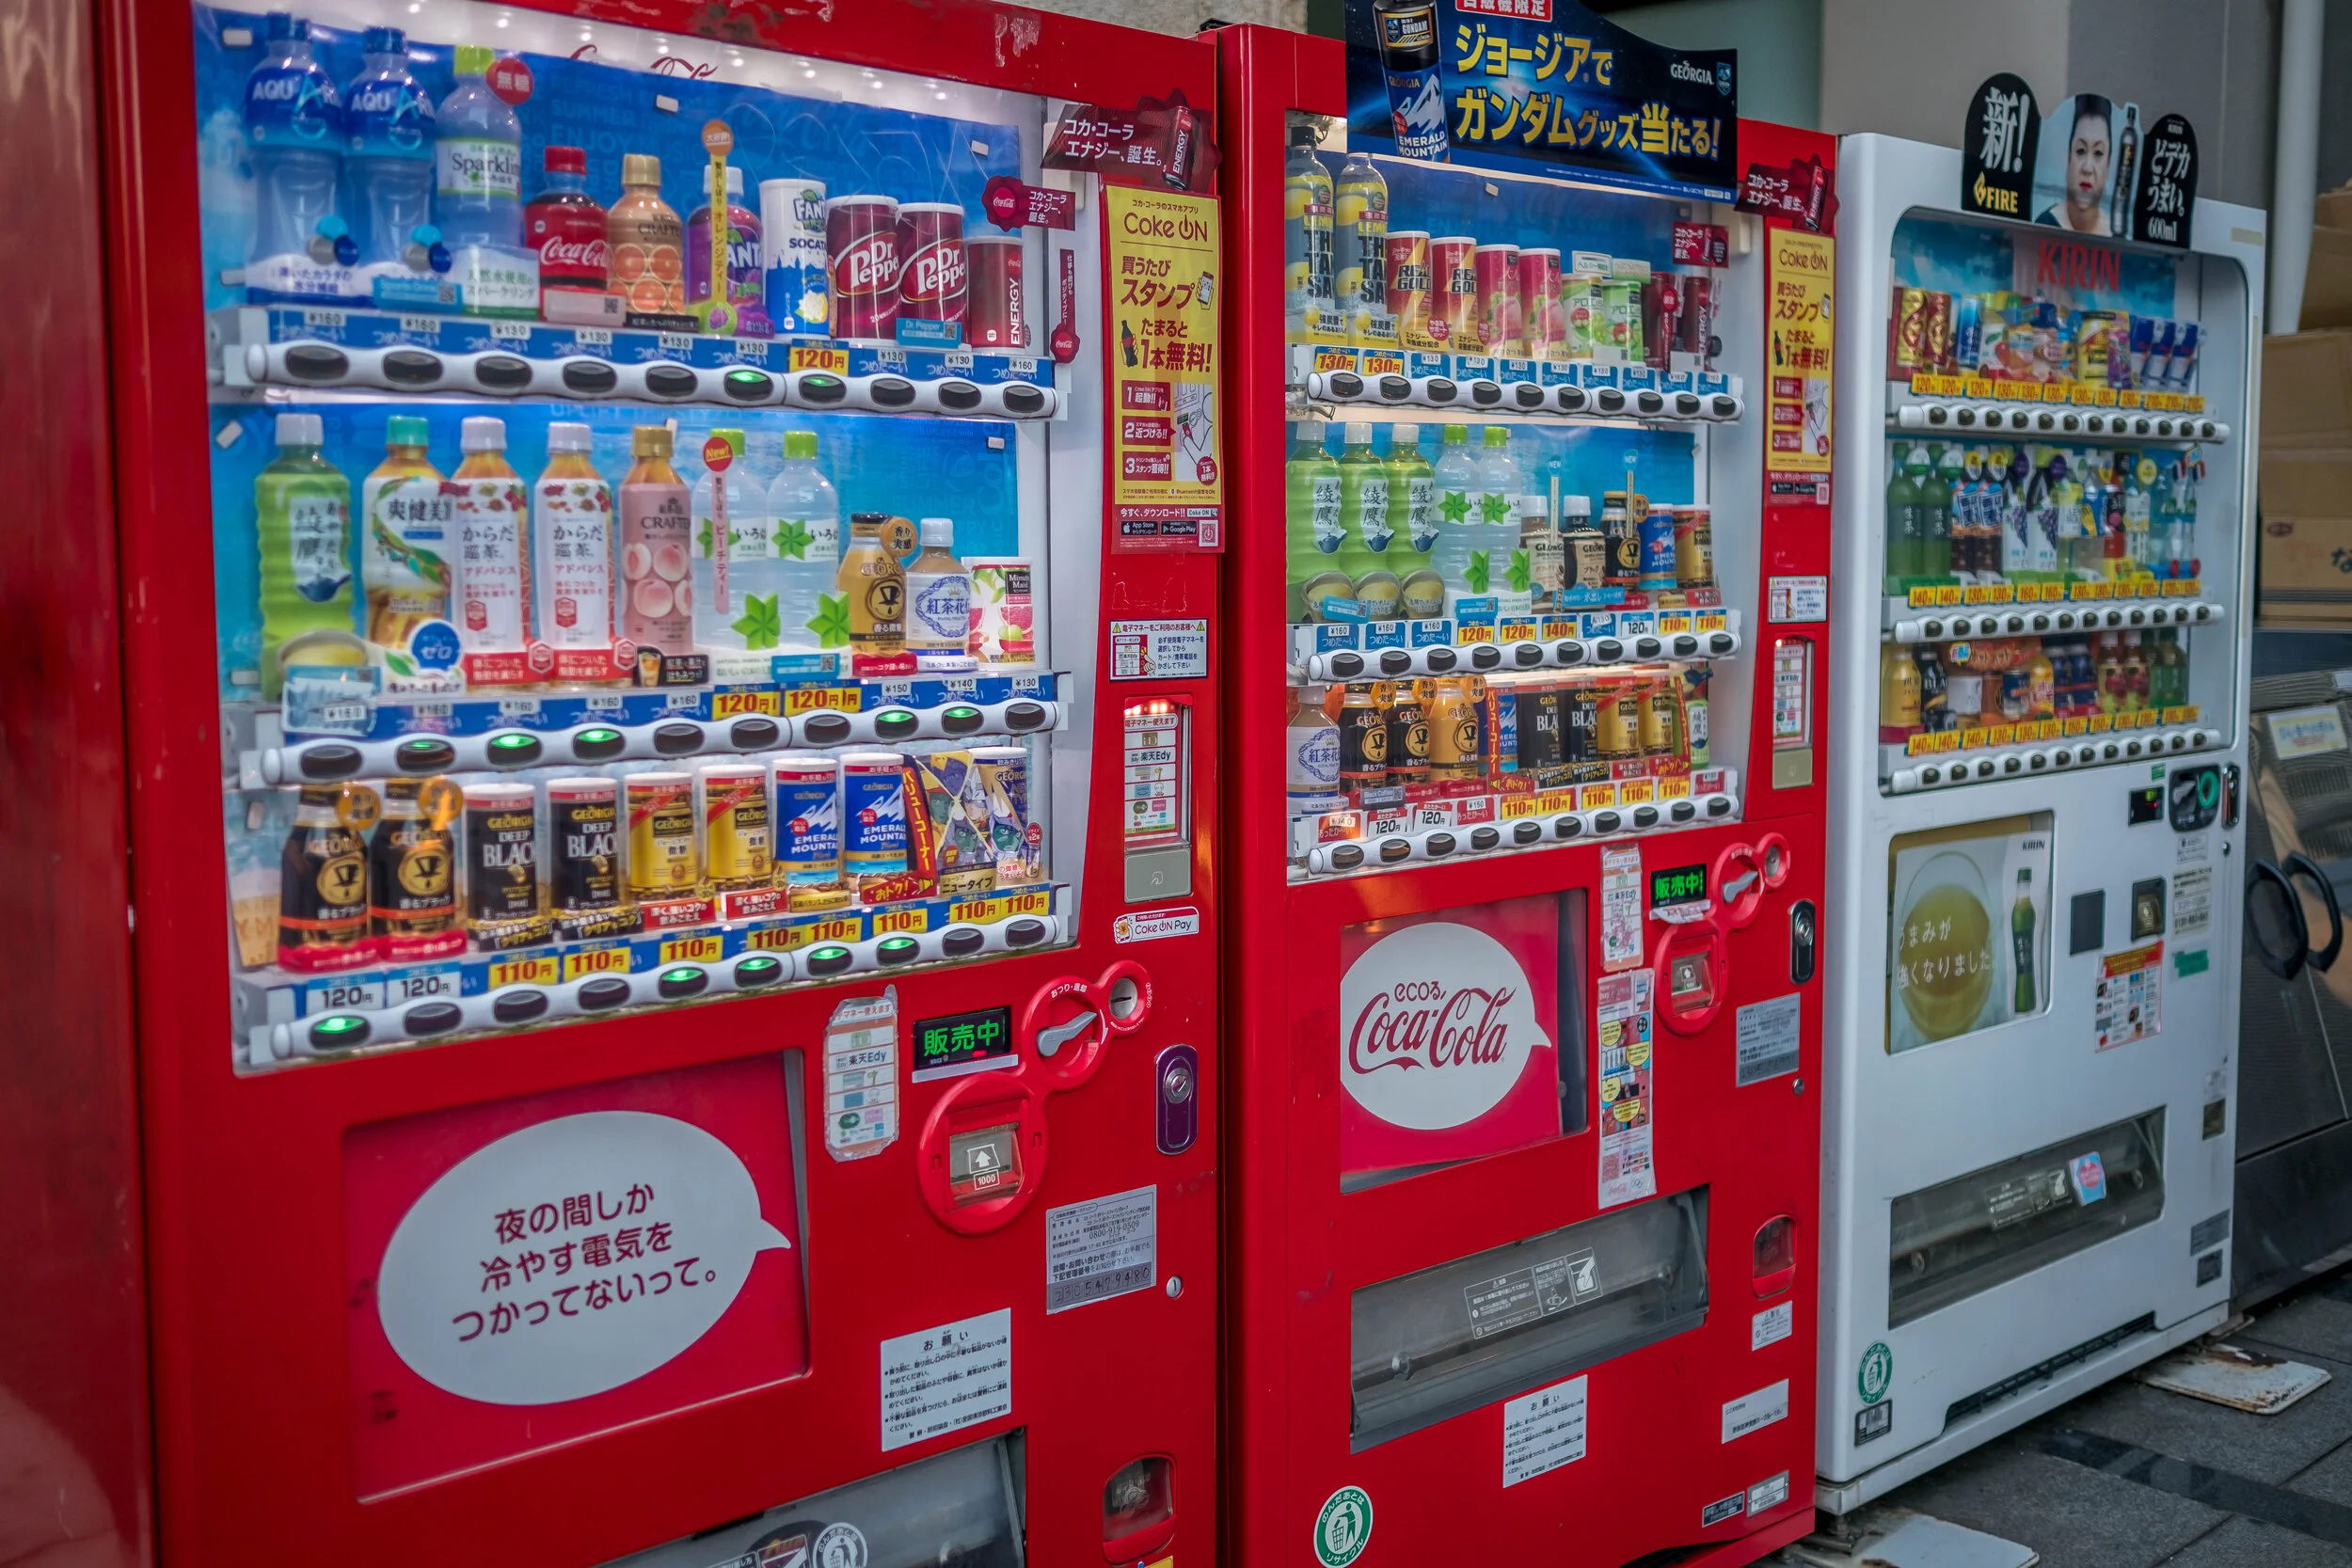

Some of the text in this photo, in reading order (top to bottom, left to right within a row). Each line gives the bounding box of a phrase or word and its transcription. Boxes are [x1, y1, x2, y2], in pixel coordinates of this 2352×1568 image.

[1402, 20, 1428, 34] GUNDAM
[1455, 23, 1613, 87] ジョージアで
[496, 71, 532, 93] 無糖
[1063, 119, 1135, 140] コカ・コーラ
[1979, 87, 2030, 173] 新!
[1399, 131, 1445, 147] EMERALD
[1065, 141, 1163, 166] エナジー、誕生。
[1172, 130, 1189, 174] ENERGY
[1399, 139, 1447, 158] MOUNTAIN
[2151, 138, 2191, 180] どデカ
[1029, 190, 1067, 203] コカ・コーラ
[1987, 186, 2019, 214] FIRE
[2147, 177, 2185, 216] うまい。
[1029, 202, 1061, 214] エナジー、
[1132, 198, 1200, 214] コカ・コーラのスマホアプリ
[1028, 213, 1049, 225] 誕生。
[1123, 212, 1208, 243] Coke ON
[2147, 217, 2178, 242] 600ml
[870, 240, 894, 261] Dr
[939, 247, 961, 269] Dr
[1779, 248, 1809, 269] Coke
[1120, 256, 1171, 277] 買うたび
[1397, 262, 1431, 278] REAL
[2038, 238, 2120, 292] KIRIN
[1397, 276, 1431, 292] GOLD
[1776, 281, 1806, 299] 買うたび
[1120, 278, 1197, 310] スタンプ
[1010, 277, 1021, 345] ENERGY
[1774, 298, 1820, 324] スタンプ
[405, 318, 437, 331] ¥160
[1140, 318, 1188, 339] たまると
[580, 330, 610, 342] ¥130
[662, 335, 691, 349] ¥130
[1786, 328, 1816, 346] たまると
[739, 341, 765, 354] ¥130
[881, 350, 904, 362] ¥130
[794, 348, 845, 369] 120円
[947, 355, 971, 366] ¥130
[1140, 340, 1213, 373] 1本無料!
[1319, 354, 1354, 372] 130円
[1422, 355, 1439, 364] ¥130
[1786, 345, 1830, 372] 1本無料!
[1011, 361, 1033, 372] ¥160
[1366, 357, 1400, 374] 130円
[1124, 421, 1135, 439] 2
[1135, 428, 1168, 439] 近づける!!
[706, 446, 730, 460] New!
[1124, 457, 1136, 475] 3
[1120, 508, 1185, 518] 今すぐ、ダウンロード!!
[1315, 483, 1335, 527] 綾鷹
[1363, 484, 1382, 528] 綾鷹
[1410, 484, 1430, 527] 綾鷹
[462, 525, 515, 542] からだ
[553, 525, 603, 542] からだ
[894, 527, 912, 538] 香り
[1169, 525, 1197, 534] Google Play
[893, 539, 913, 551] 実感
[1012, 581, 1028, 590] Maid
[1121, 623, 1197, 633] 電子マネーをご利用のお客様へ
[1331, 626, 1348, 636] ¥160
[1377, 623, 1395, 633] ¥160
[1424, 621, 1440, 631] ¥160
[1461, 626, 1492, 642] 120円
[1505, 625, 1534, 641] 120円
[1546, 622, 1575, 638] 140円
[1157, 636, 1205, 644] 必ず使用電子マネーを
[1157, 644, 1186, 653] 選択してから
[421, 646, 453, 659] ゼロ
[1157, 653, 1198, 661] カード/携帯電話を
[885, 684, 908, 694] ¥150
[949, 678, 973, 689] ¥140
[1014, 677, 1037, 688] ¥130
[1380, 683, 1393, 692] 香り
[1422, 680, 1435, 689] 香り
[1471, 677, 1485, 688] 香り
[671, 694, 697, 705] ¥160
[788, 689, 839, 709] 120円
[1379, 692, 1393, 704] 実感
[1421, 689, 1435, 700] 実感
[1471, 687, 1486, 698] 実感
[592, 698, 619, 708] ¥160
[1487, 689, 1498, 774] バリューコーナー
[1140, 749, 1171, 763] 楽天Edy
[1504, 778, 1528, 791] おトク!
[1505, 801, 1534, 817] 110円
[902, 769, 930, 873] バリューコーナー
[1375, 819, 1401, 834] 120円
[1422, 811, 1445, 825] 120円
[581, 823, 612, 834] DEEP
[2022, 840, 2045, 851] KIRIN
[875, 883, 909, 901] おトク!
[942, 878, 993, 895] ニュータイプ
[1655, 875, 1700, 900] 販売中
[955, 901, 995, 920] 110円
[1004, 895, 1045, 912] 110円
[879, 911, 922, 931] 110円
[1135, 919, 1192, 936] Coke ON Pay
[753, 928, 801, 948] 110円
[811, 922, 856, 942] 110円
[1897, 915, 1952, 950] うまみが
[667, 940, 717, 960] 110円
[572, 951, 624, 974] 110円
[1897, 950, 1997, 991] 強くなりました。
[323, 987, 373, 1008] 120円
[1050, 982, 1089, 1000] おつり・返却
[1348, 985, 1518, 1074] Coca-Cola
[924, 1020, 1000, 1057] 販売中
[849, 1051, 887, 1067] 楽天Edy
[977, 1173, 997, 1186] 1000
[493, 1182, 656, 1245] 夜の間しか
[478, 1221, 673, 1293] 冷やす電気を
[451, 1256, 717, 1343] つかってないって。
[1322, 1492, 1365, 1523] のんだあとは
[1327, 1538, 1364, 1564] リサイクル
